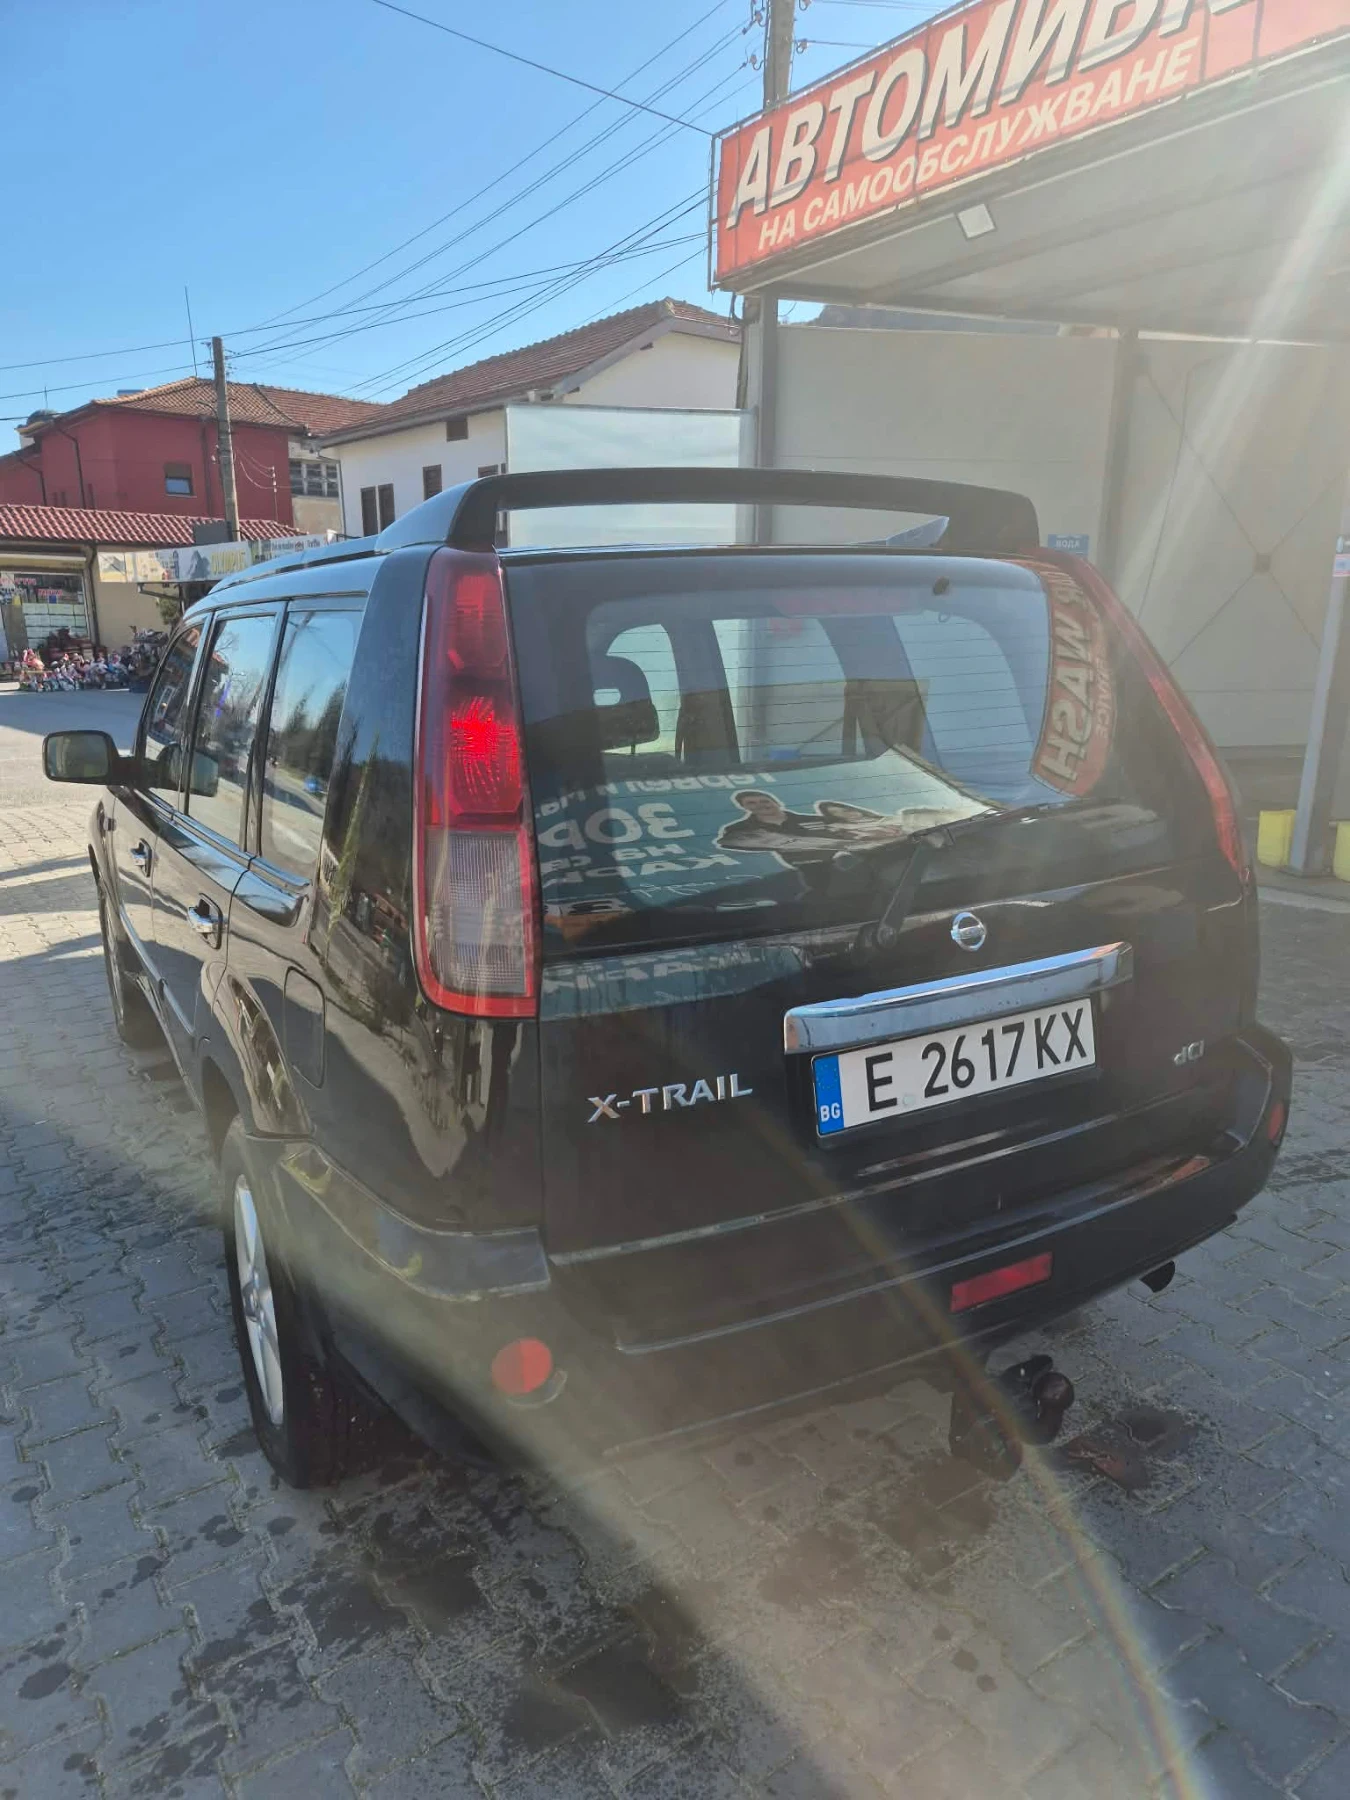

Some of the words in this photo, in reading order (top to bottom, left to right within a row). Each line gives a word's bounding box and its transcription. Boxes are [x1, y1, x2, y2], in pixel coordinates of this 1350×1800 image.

[726, 0, 1249, 230] АВТОМИВ
[758, 208, 796, 250] НА
[802, 36, 1198, 232] САМООБСЛУЖВАНЕ
[587, 1073, 753, 1123] X-TRAIL
[865, 1052, 898, 1112] E
[820, 1103, 841, 1122] BG
